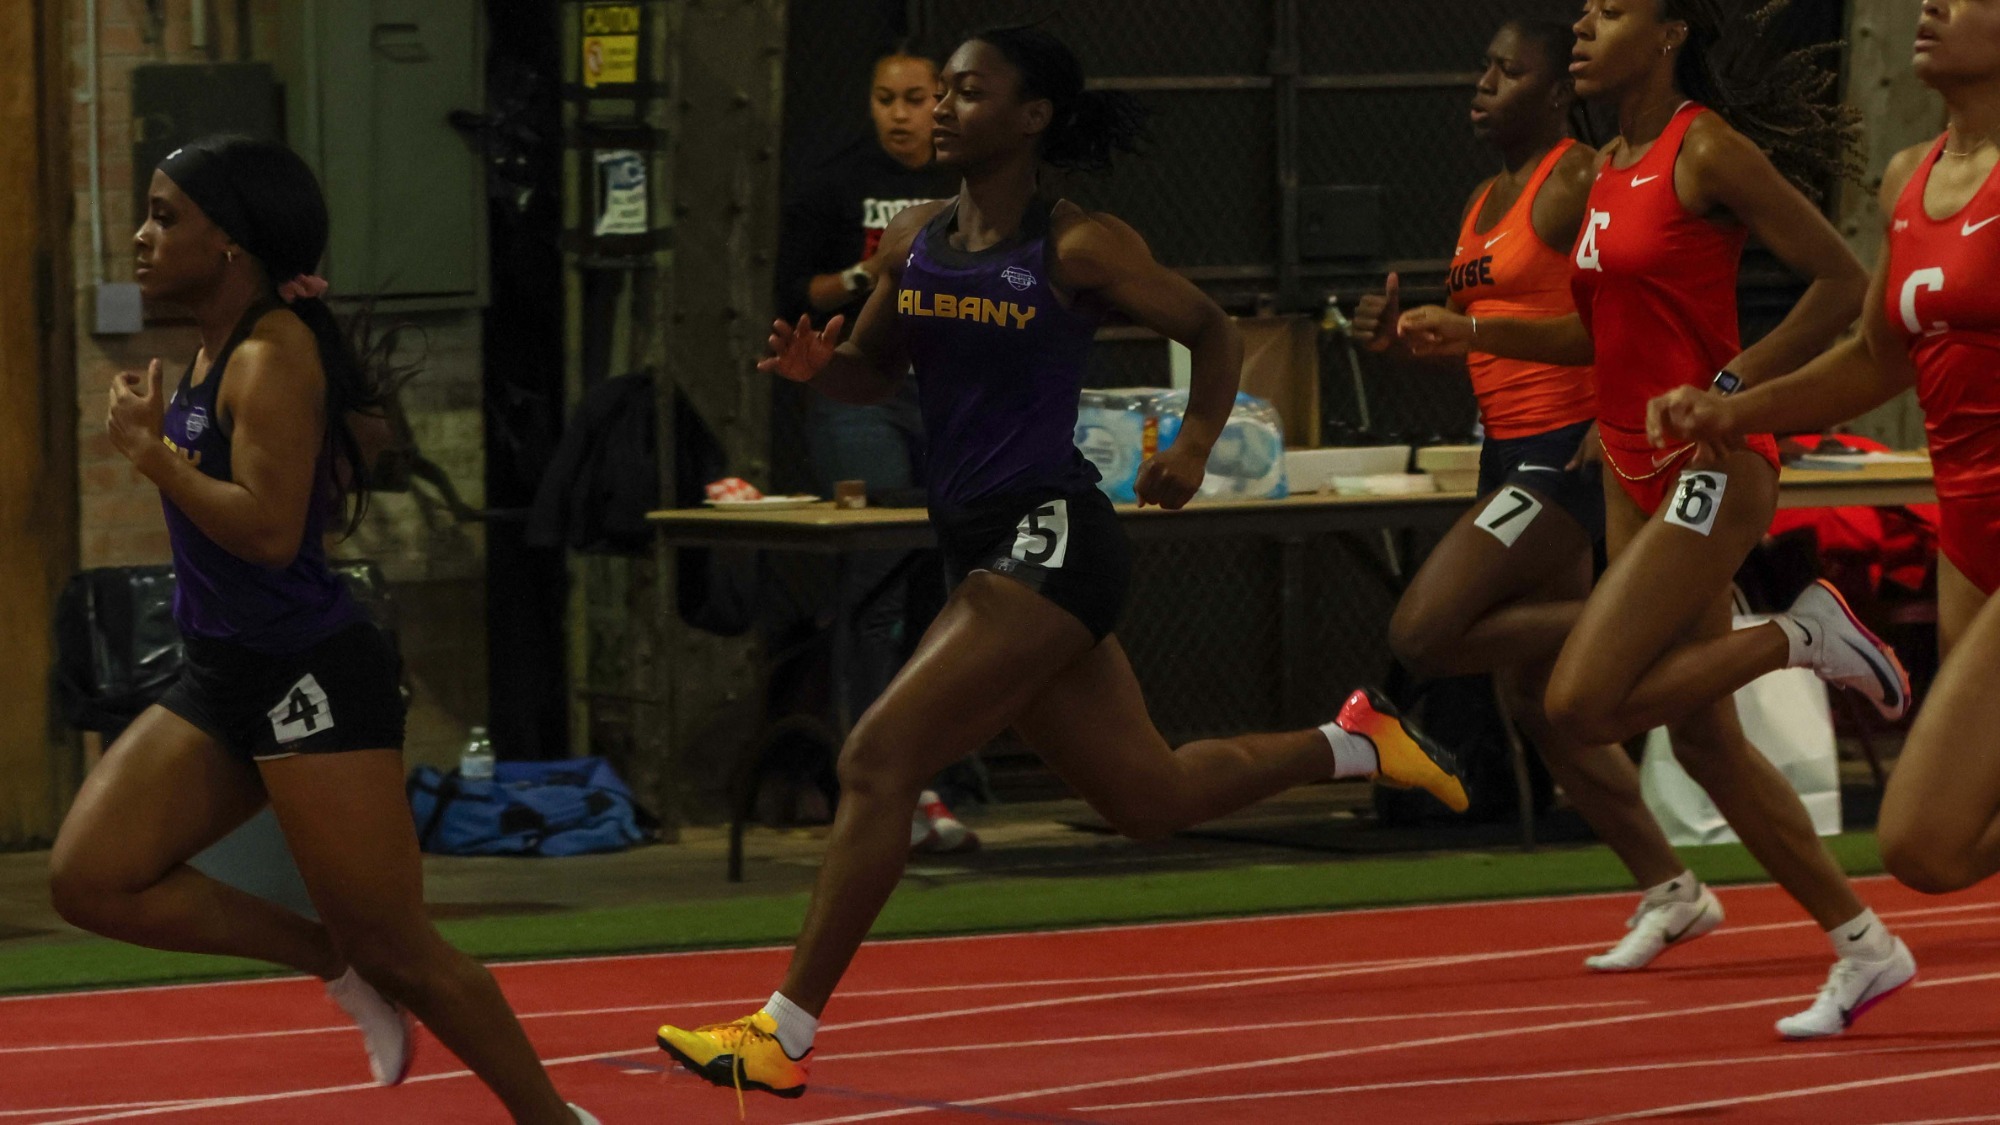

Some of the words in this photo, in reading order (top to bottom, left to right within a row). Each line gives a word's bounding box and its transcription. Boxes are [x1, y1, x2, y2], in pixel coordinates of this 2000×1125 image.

[1449, 255, 1494, 293] USE
[897, 288, 1037, 330] ALBANY
[1487, 490, 1534, 530] 7
[1675, 473, 1717, 526] 6
[1023, 505, 1058, 567] 5
[281, 687, 320, 732] 4
